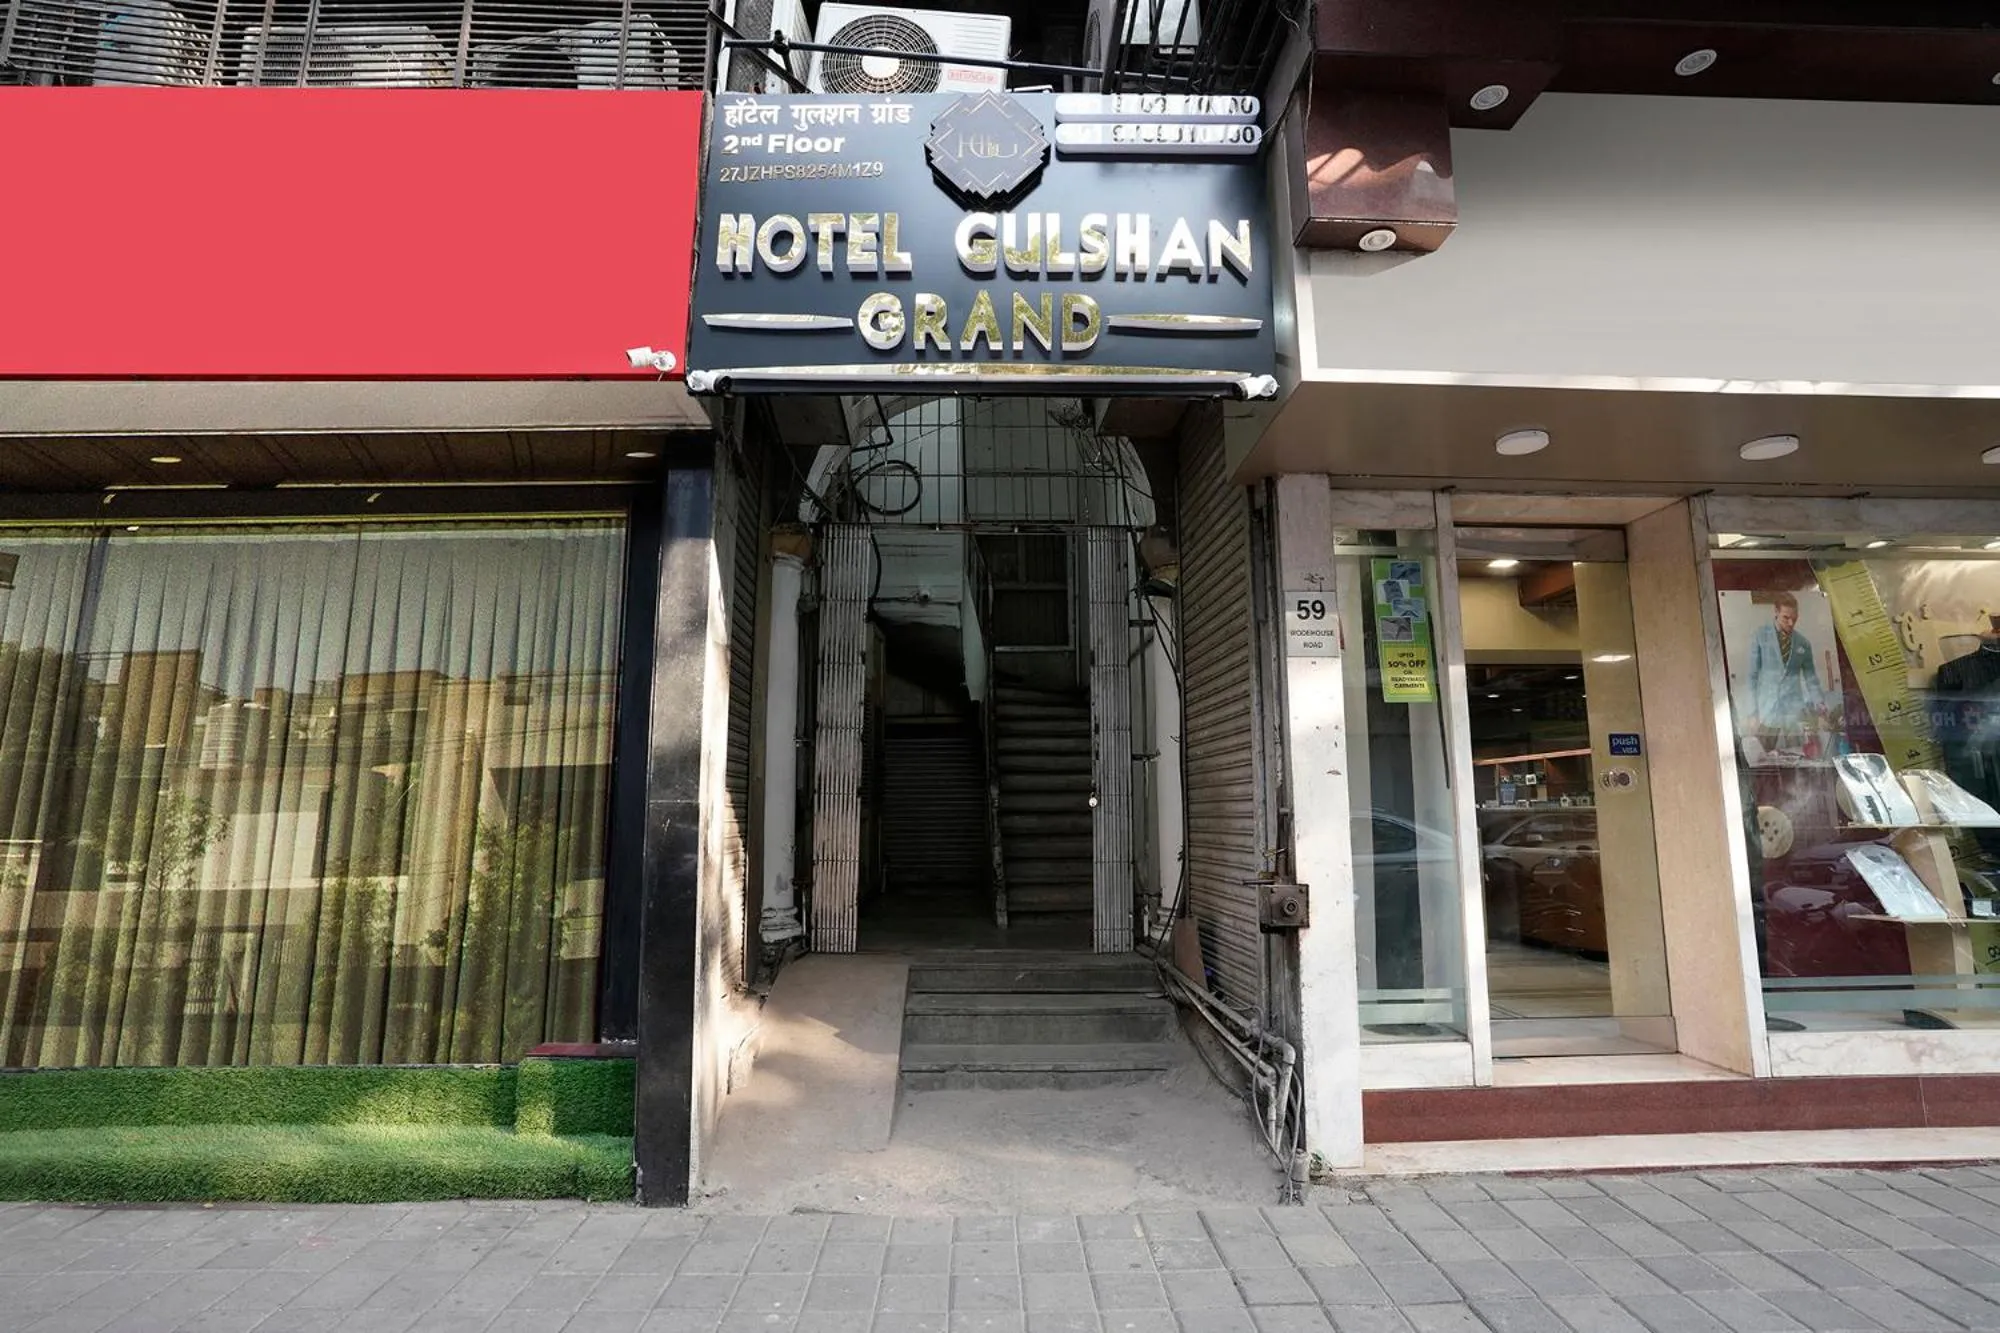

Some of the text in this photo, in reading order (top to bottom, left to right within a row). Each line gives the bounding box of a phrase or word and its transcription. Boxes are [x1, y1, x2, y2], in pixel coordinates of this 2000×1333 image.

[723, 98, 781, 128] हॉटेल
[789, 102, 862, 130] गुलशन
[722, 133, 846, 155] 2nd Floor
[716, 211, 1254, 284] HOTEL GULSHAN
[857, 289, 1101, 352] GRAND
[1296, 599, 1326, 620] 59
[1408, 660, 1426, 668] OFF
[1868, 653, 1883, 666] 2
[1887, 700, 1902, 713] 3
[1611, 736, 1638, 747] push
